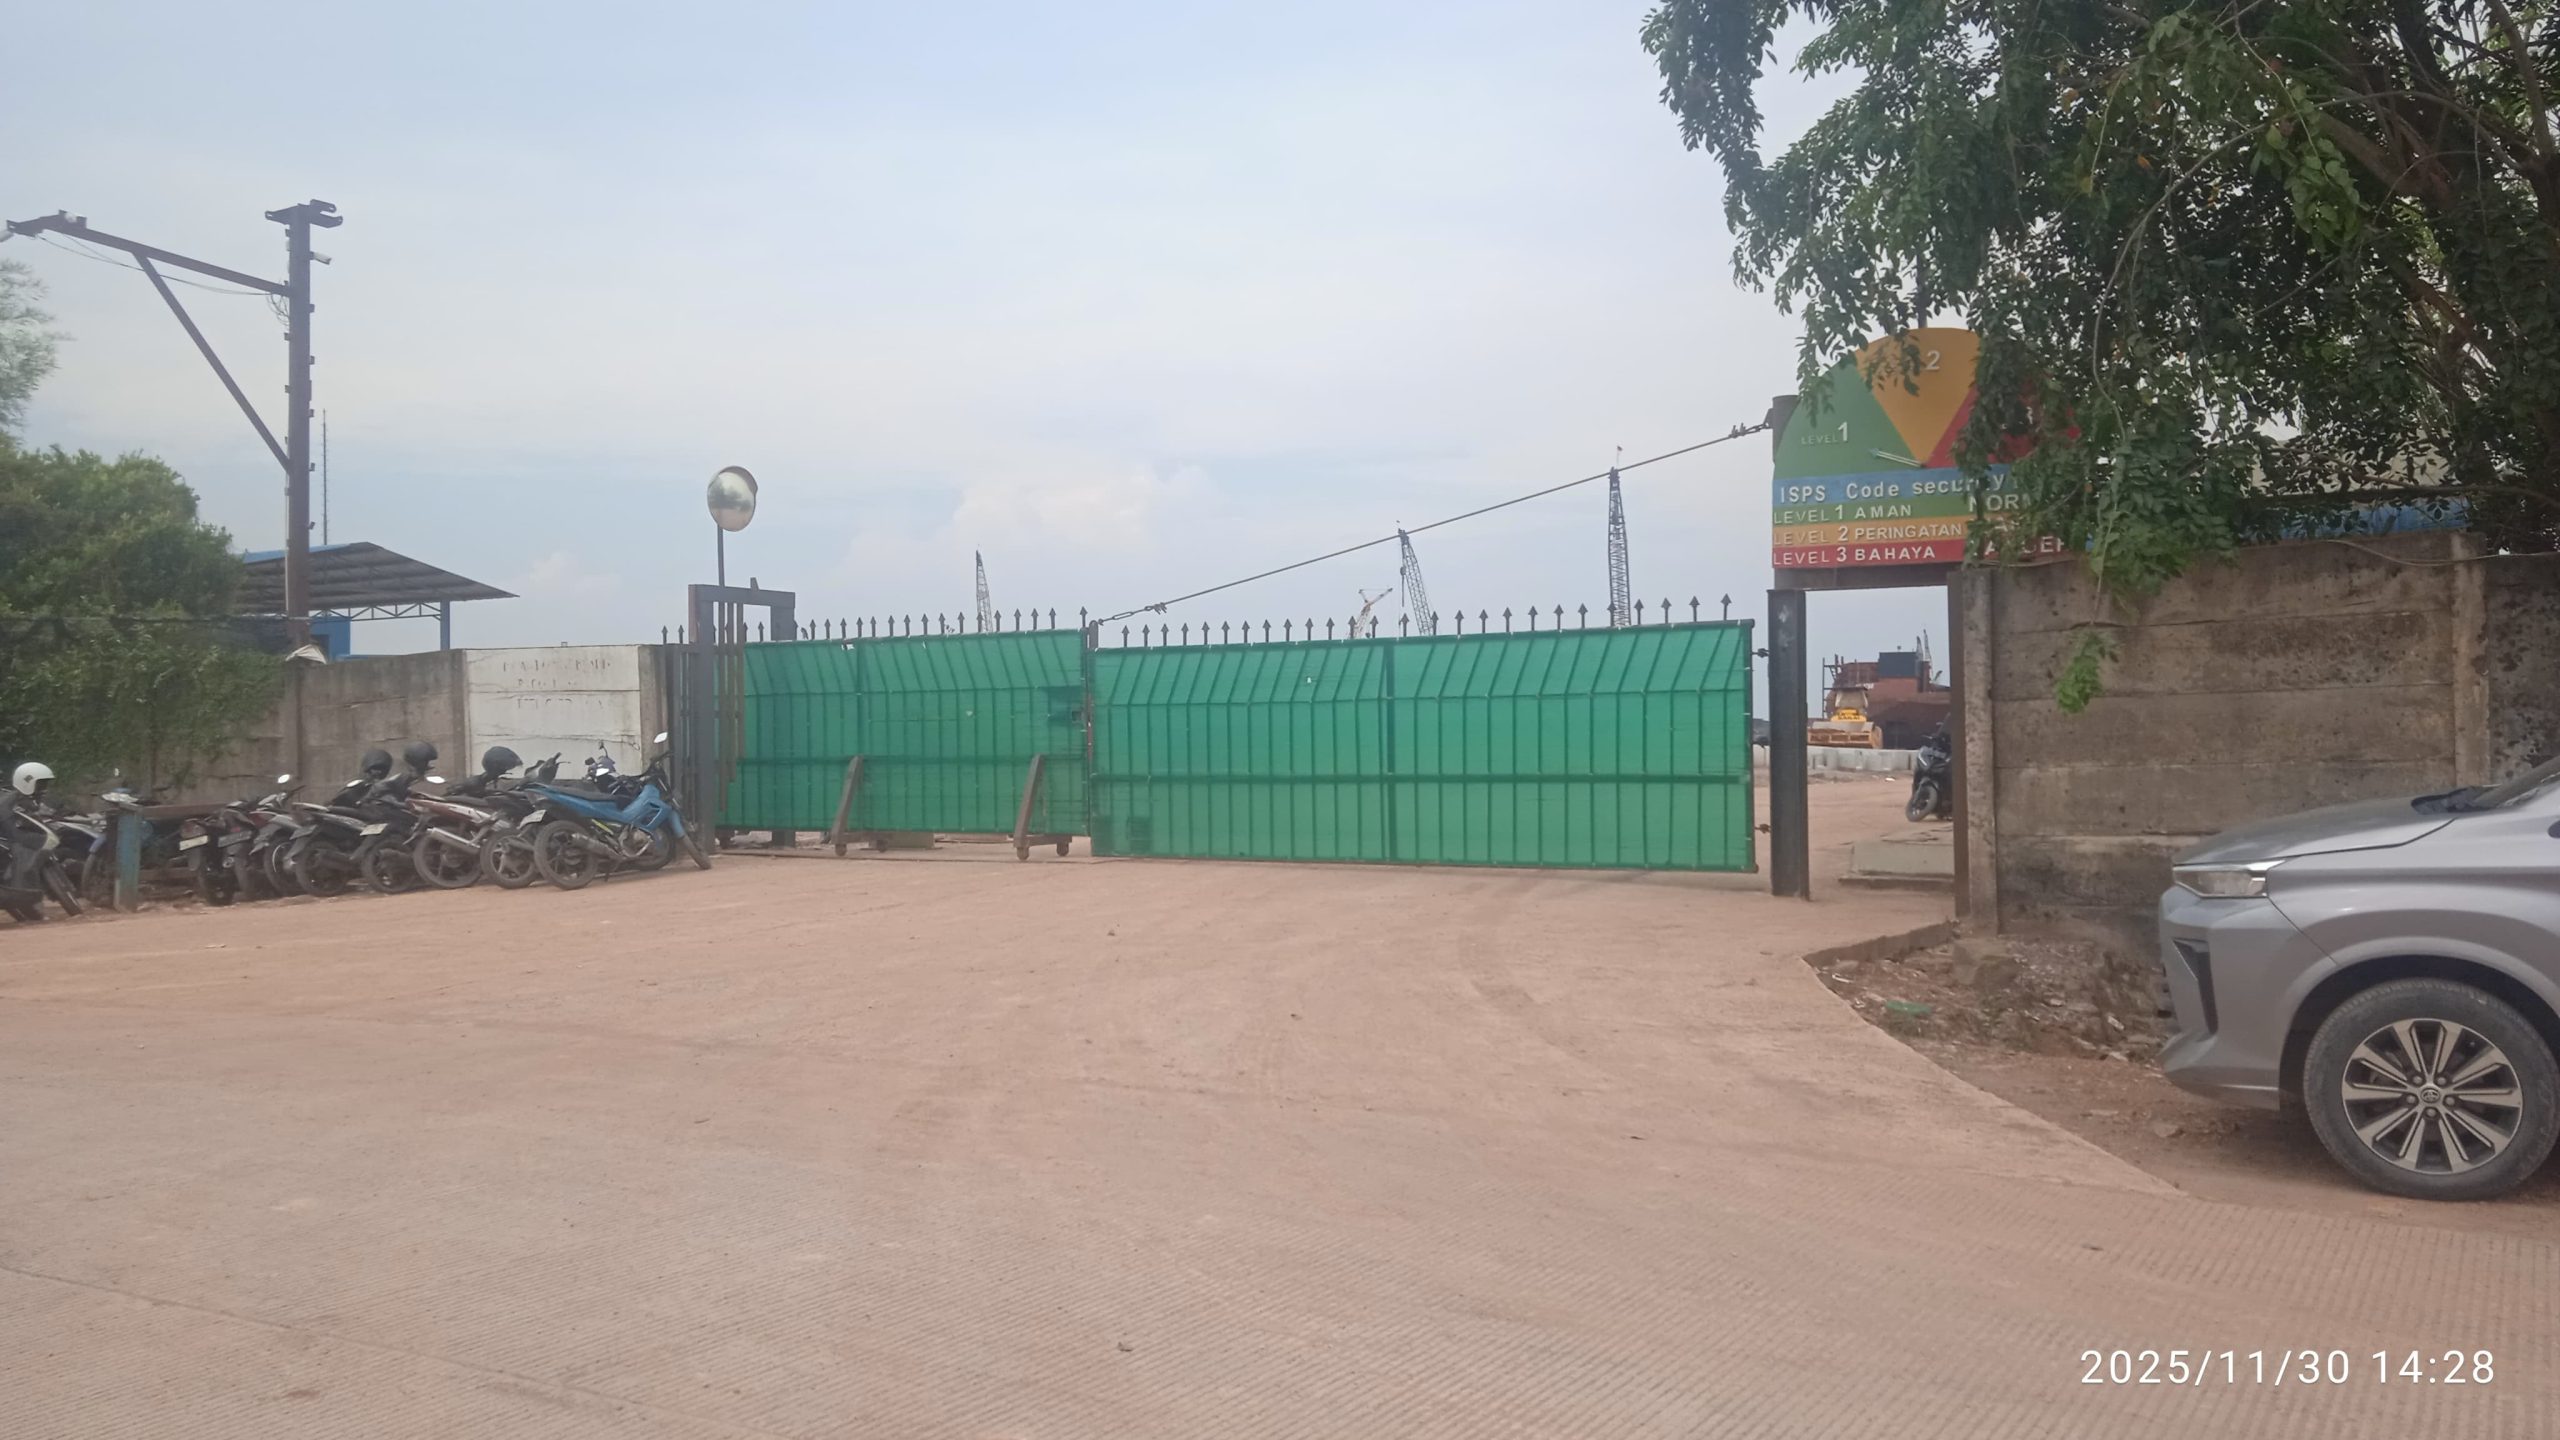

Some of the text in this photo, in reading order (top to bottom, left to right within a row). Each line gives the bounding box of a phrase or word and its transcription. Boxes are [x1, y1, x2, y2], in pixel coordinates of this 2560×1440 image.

[1924, 348, 1942, 371] 2
[1800, 421, 1849, 446] LEVEL 1
[1780, 485, 1827, 504] ISPS
[1846, 481, 1900, 500] Code
[1773, 508, 1830, 524] LEVEL
[1834, 504, 1844, 520] 1
[1854, 504, 1912, 520] AMAN
[1773, 530, 1830, 546] LEVEL
[1837, 525, 1849, 542] 2
[1854, 523, 1962, 541] PERINGATAN
[1773, 550, 1830, 566] LEVEL
[1836, 546, 1848, 563] 3
[1854, 546, 1936, 562] BAHAYA
